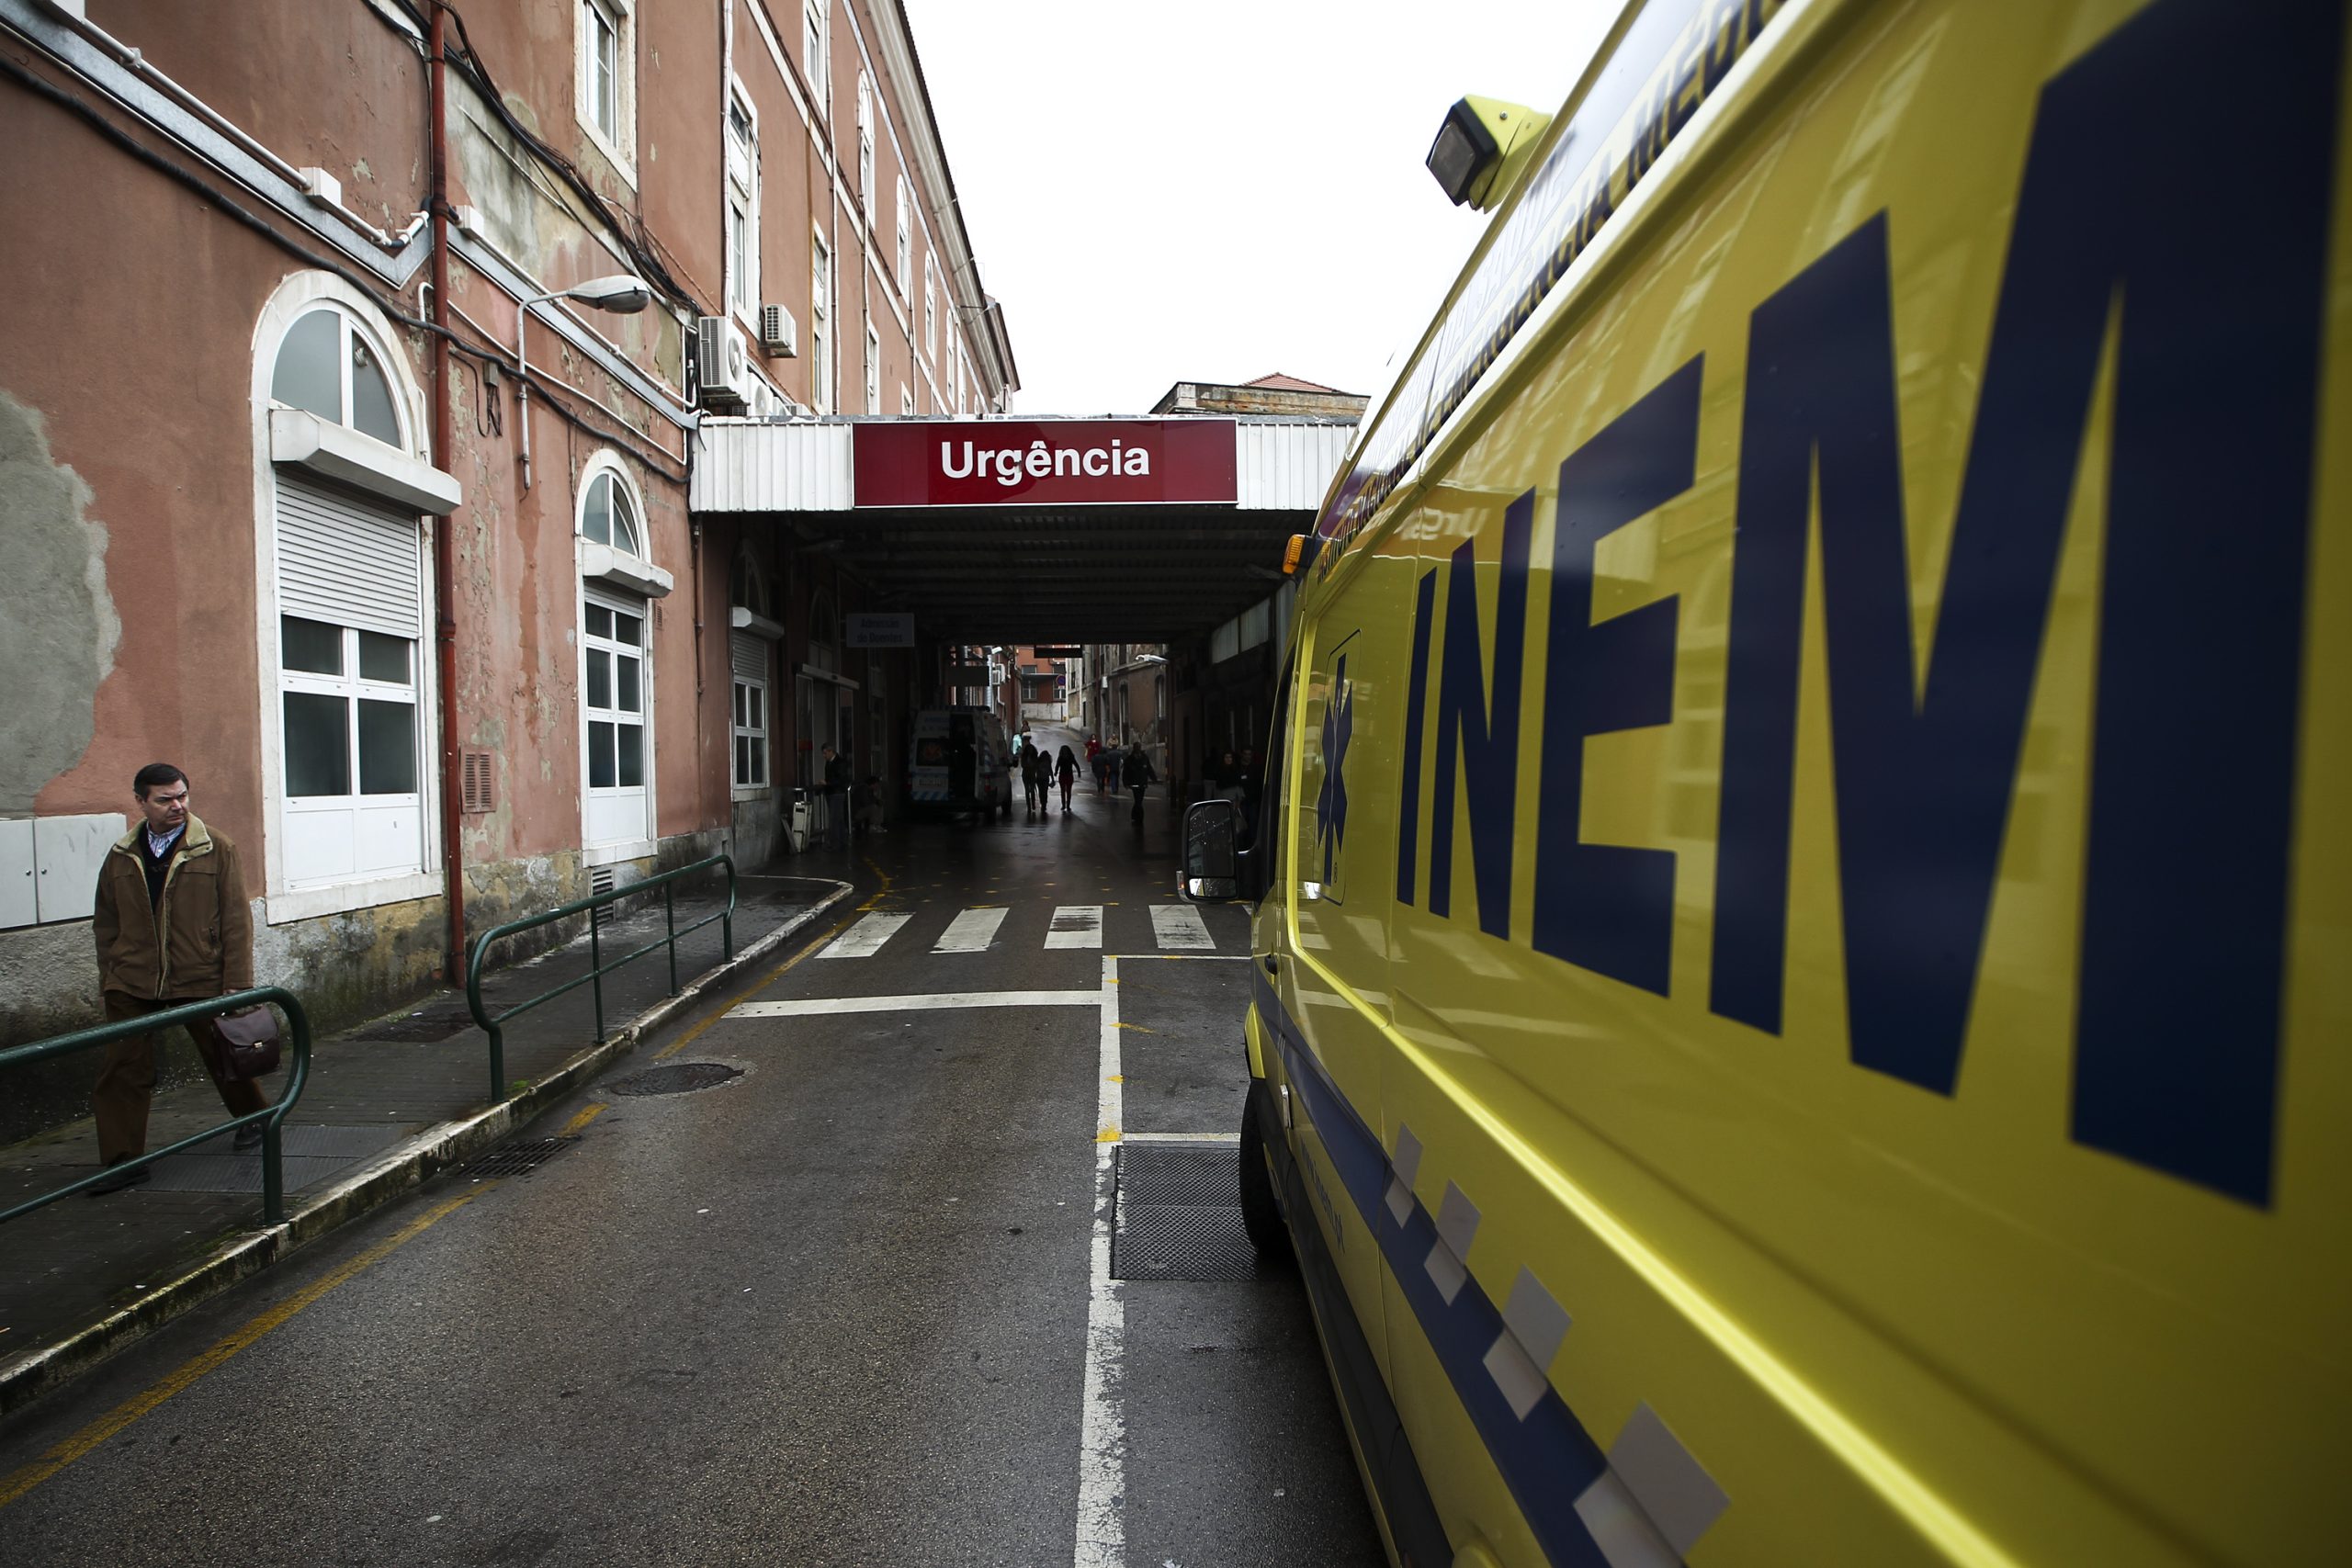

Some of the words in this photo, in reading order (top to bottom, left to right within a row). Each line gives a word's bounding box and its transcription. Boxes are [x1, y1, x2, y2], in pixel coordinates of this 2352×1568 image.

[1441, 147, 1614, 426] EMERGÊNCIA
[941, 439, 1150, 486] Urgência
[1396, 0, 2348, 1213] INEM
